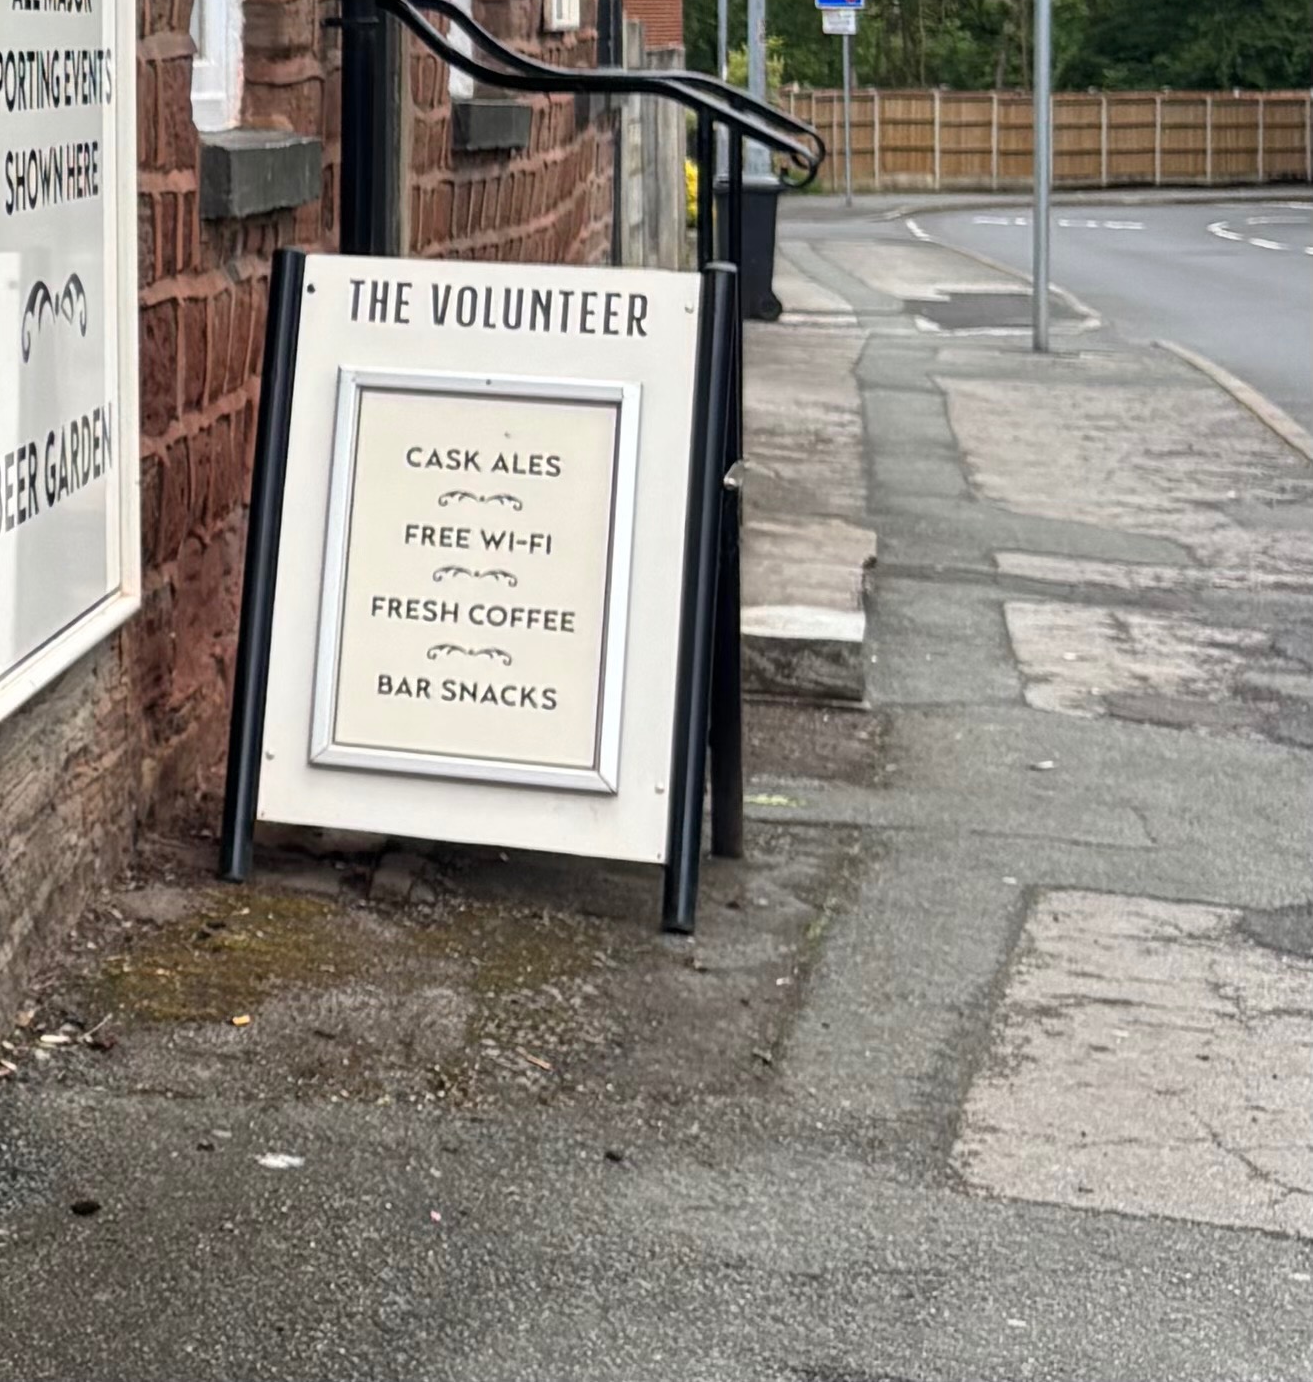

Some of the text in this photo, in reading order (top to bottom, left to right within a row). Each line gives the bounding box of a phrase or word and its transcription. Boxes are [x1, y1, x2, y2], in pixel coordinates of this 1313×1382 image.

[64, 48, 112, 107] EVENTS
[4, 140, 99, 216] SHOWN HERE
[349, 279, 649, 338] THE VOLUNTEER
[44, 400, 113, 508] GARDEN
[405, 447, 563, 477] CASK ALES
[404, 524, 553, 556] FREE WI-FI
[371, 596, 577, 634] FRESH COFFEE
[377, 674, 559, 711] BAR SNACKS
